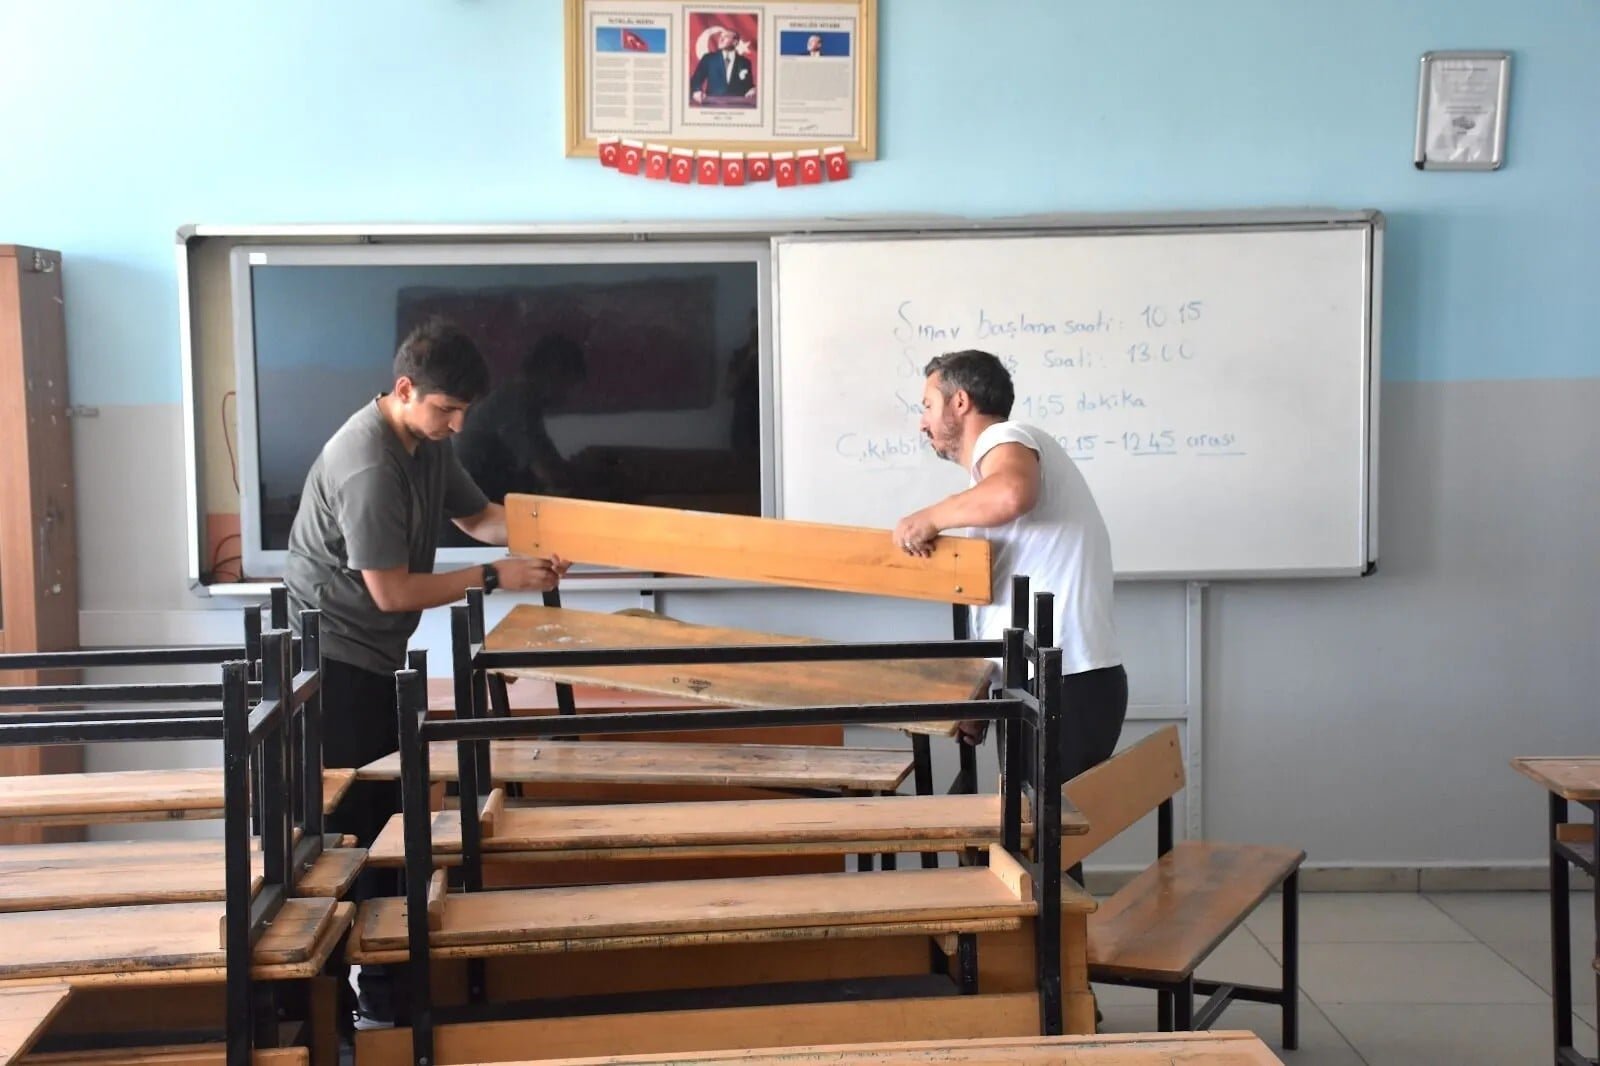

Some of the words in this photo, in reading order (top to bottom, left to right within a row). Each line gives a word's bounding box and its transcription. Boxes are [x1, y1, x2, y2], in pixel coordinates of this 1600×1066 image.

[892, 300, 960, 343] Sınav
[1022, 394, 1065, 419] 165
[1076, 389, 1147, 412] dakika
